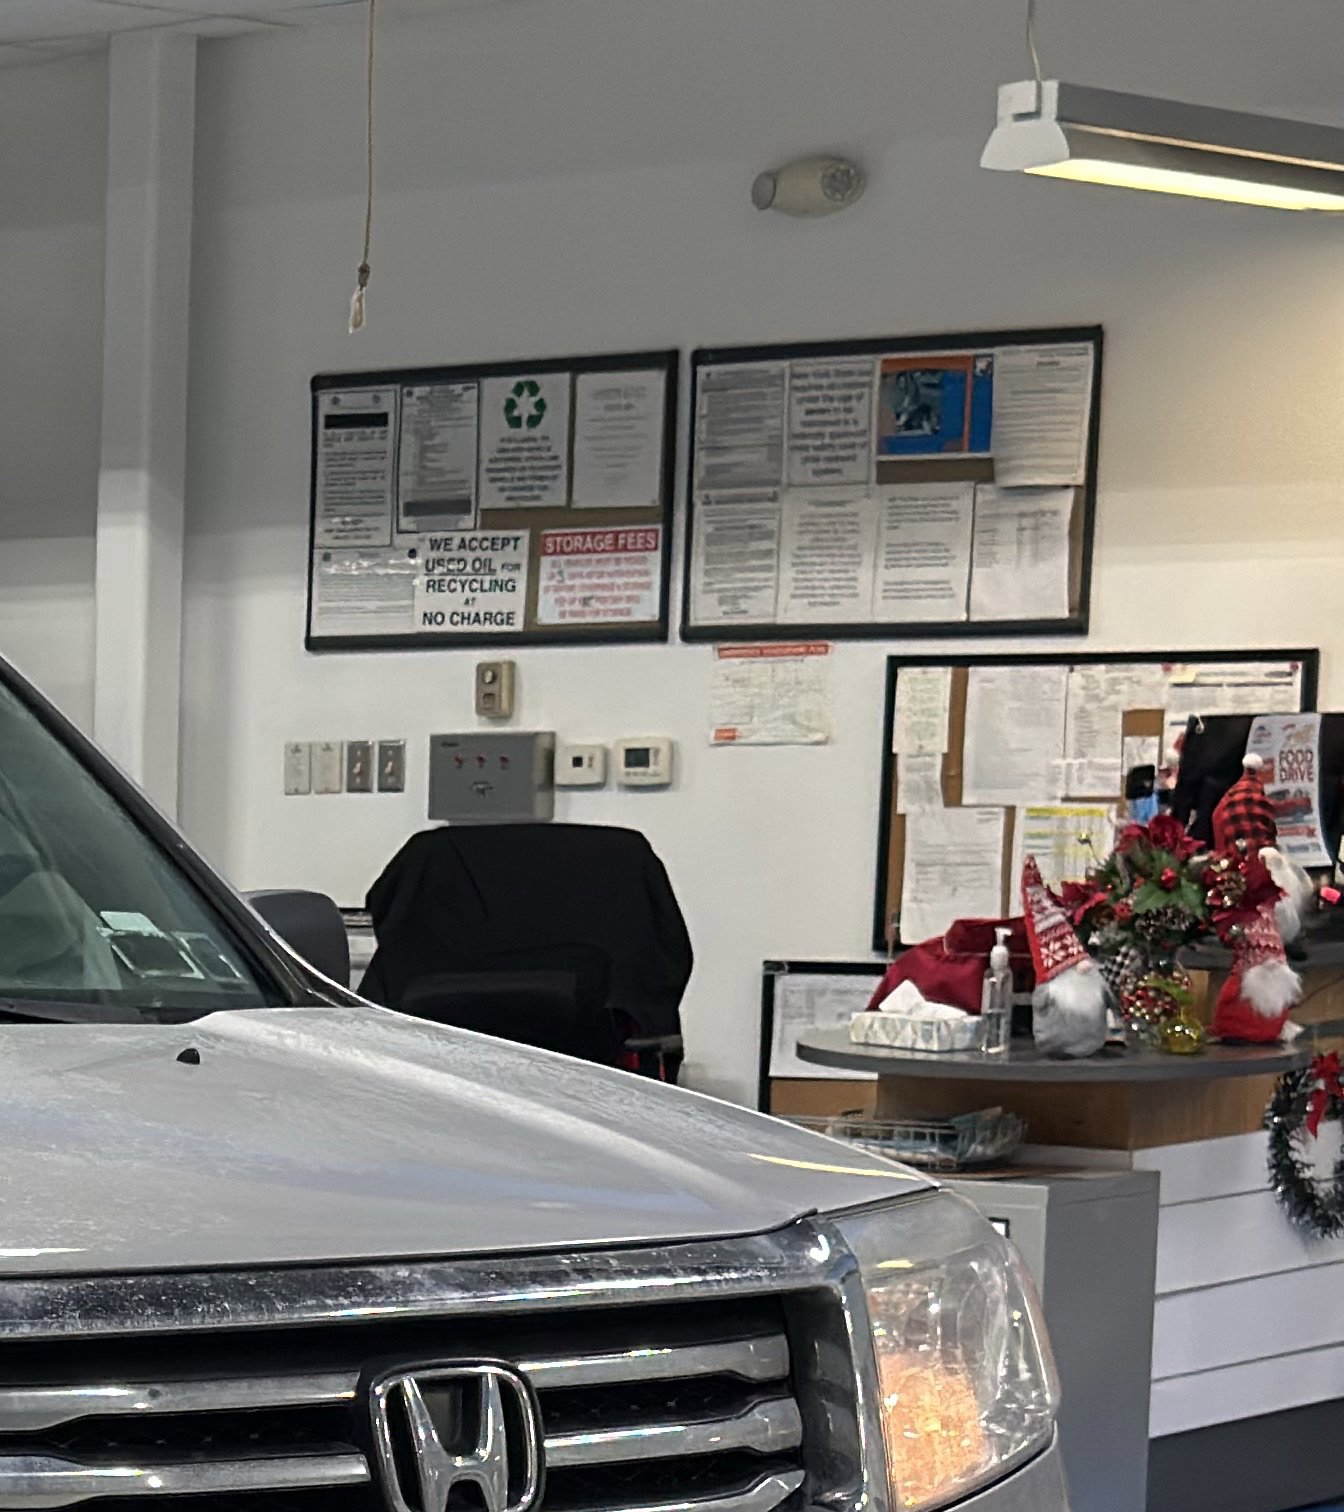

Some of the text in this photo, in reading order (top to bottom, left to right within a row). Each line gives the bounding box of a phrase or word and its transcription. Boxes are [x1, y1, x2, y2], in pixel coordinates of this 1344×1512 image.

[429, 536, 521, 551] WE ACCEPT
[544, 531, 657, 554] STORAGE FEES
[471, 557, 497, 573] OIL
[425, 577, 517, 593] RECYCLING
[422, 611, 516, 627] NO CHARGE
[1278, 750, 1314, 767] FOOD
